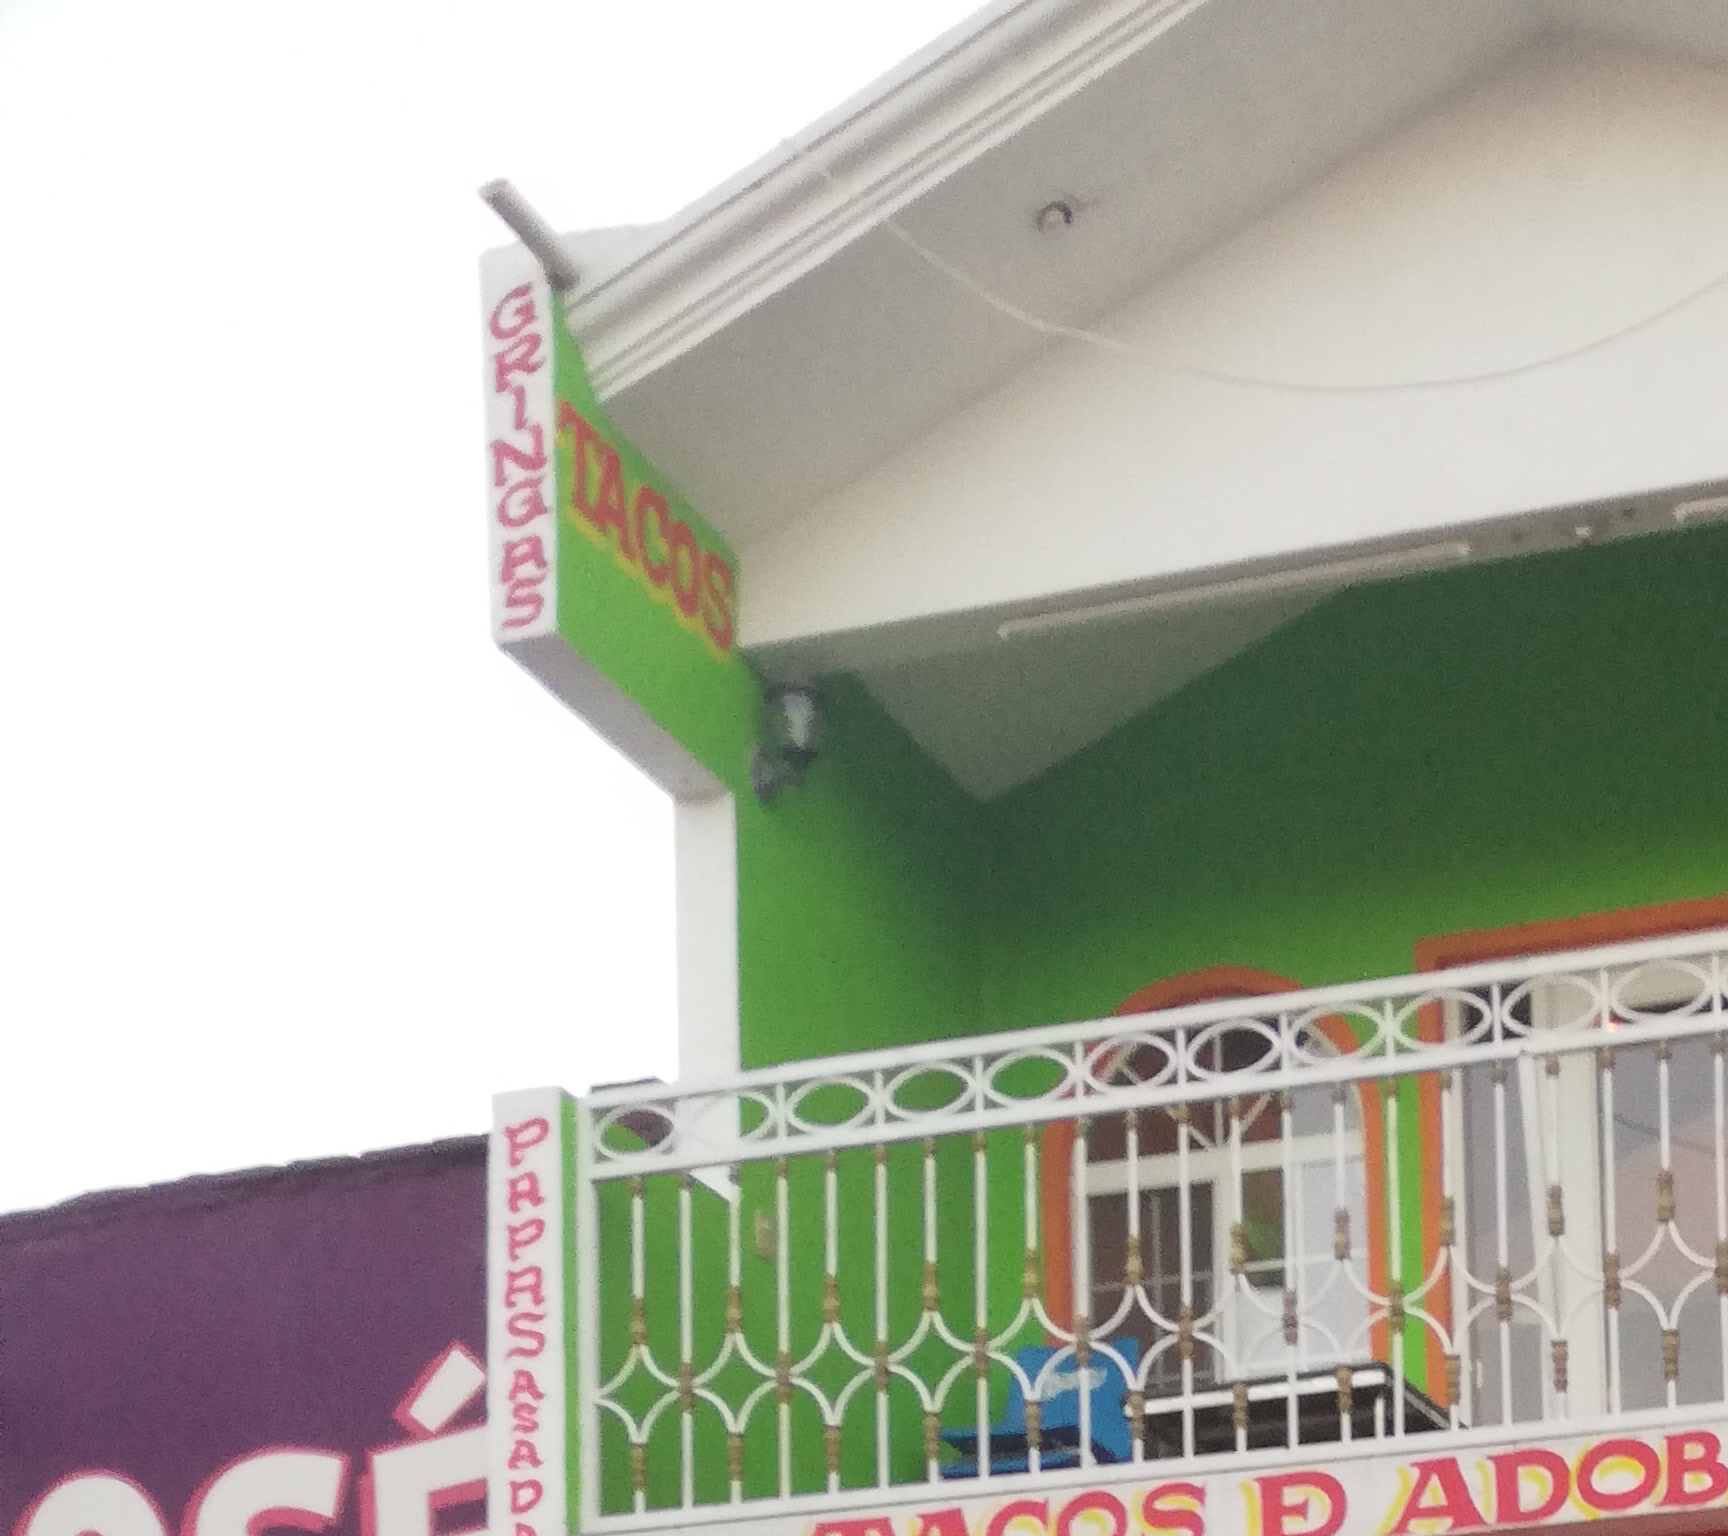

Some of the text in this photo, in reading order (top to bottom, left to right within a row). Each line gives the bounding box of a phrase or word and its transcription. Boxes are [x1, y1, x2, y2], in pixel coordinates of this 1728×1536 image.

[488, 283, 548, 628] GRINGAS
[556, 400, 736, 650] TACOS
[503, 1116, 550, 1359] PAPAS
